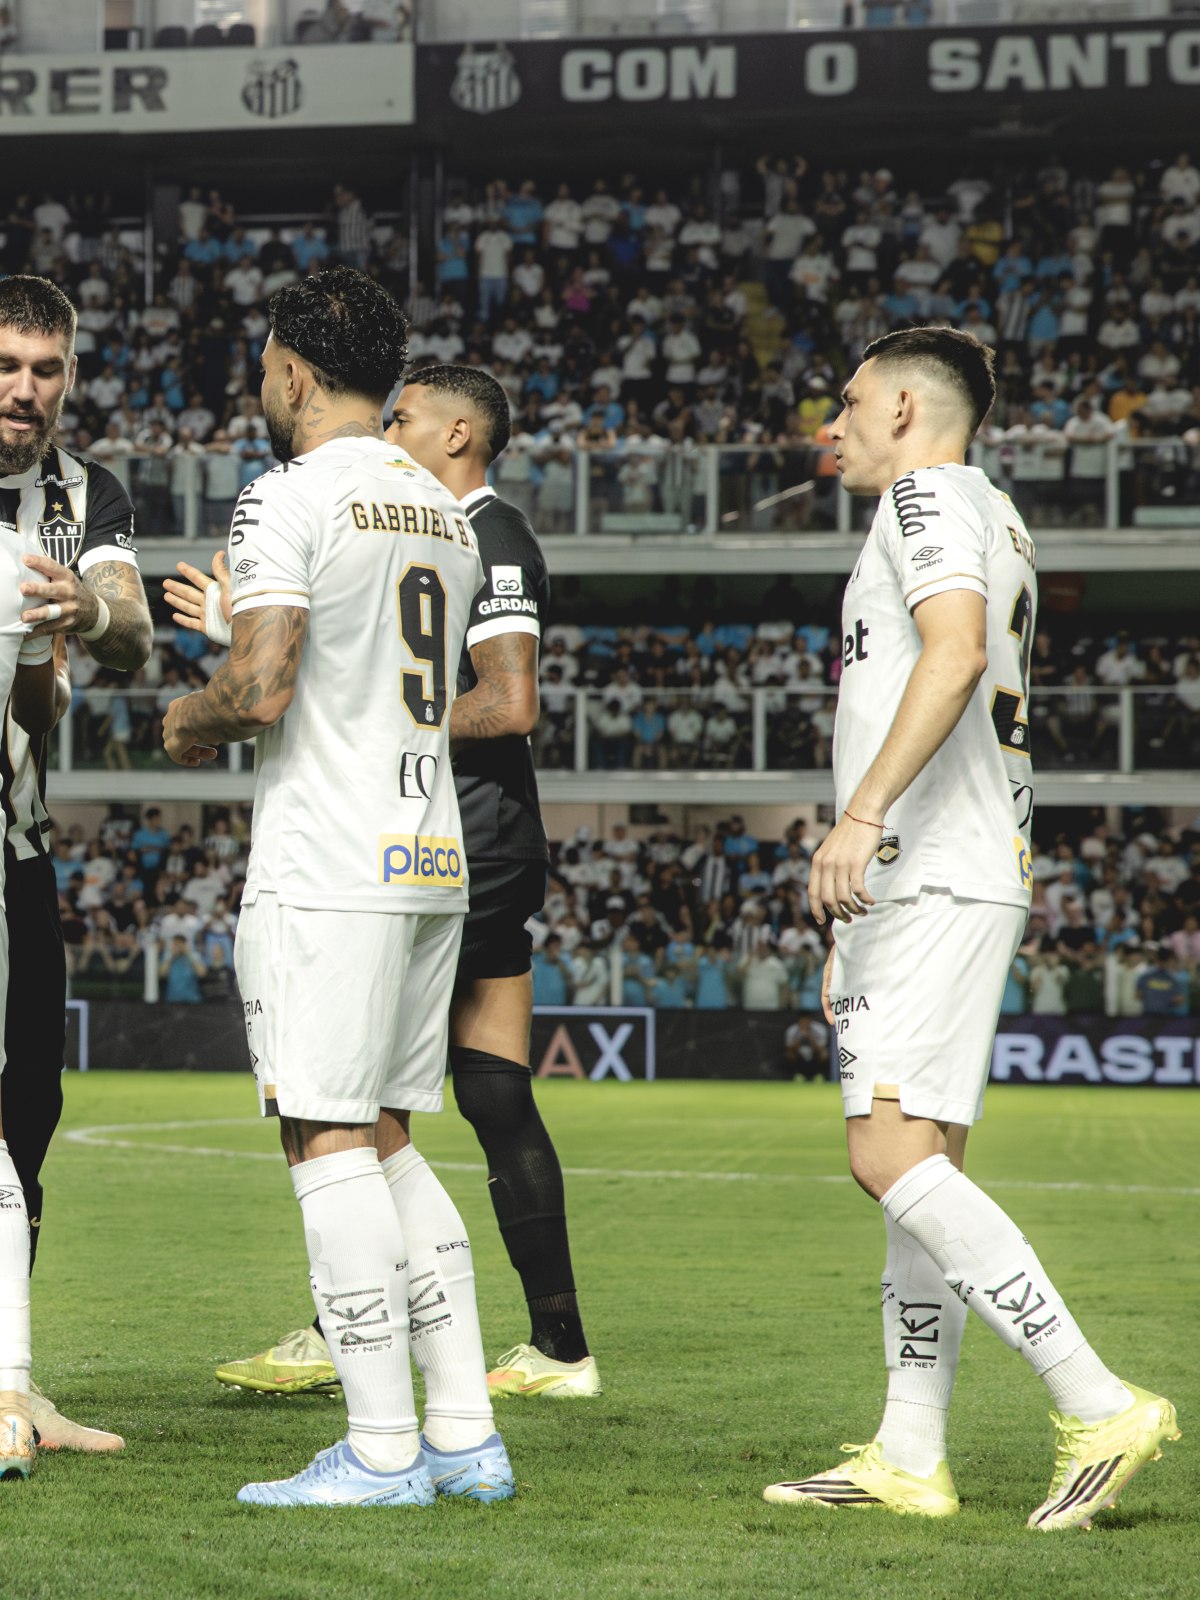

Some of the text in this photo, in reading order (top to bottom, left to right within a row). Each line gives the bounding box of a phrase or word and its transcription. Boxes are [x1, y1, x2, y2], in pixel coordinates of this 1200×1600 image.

[561, 46, 737, 101] COM
[805, 43, 857, 95] O
[350, 501, 454, 543] GABRIEL
[915, 558, 943, 571] umbro
[478, 597, 538, 615] GERDAU
[398, 561, 449, 732] 9
[383, 835, 461, 882] placo
[991, 1033, 1200, 1083] RASI
[363, 1342, 392, 1352] NEY
